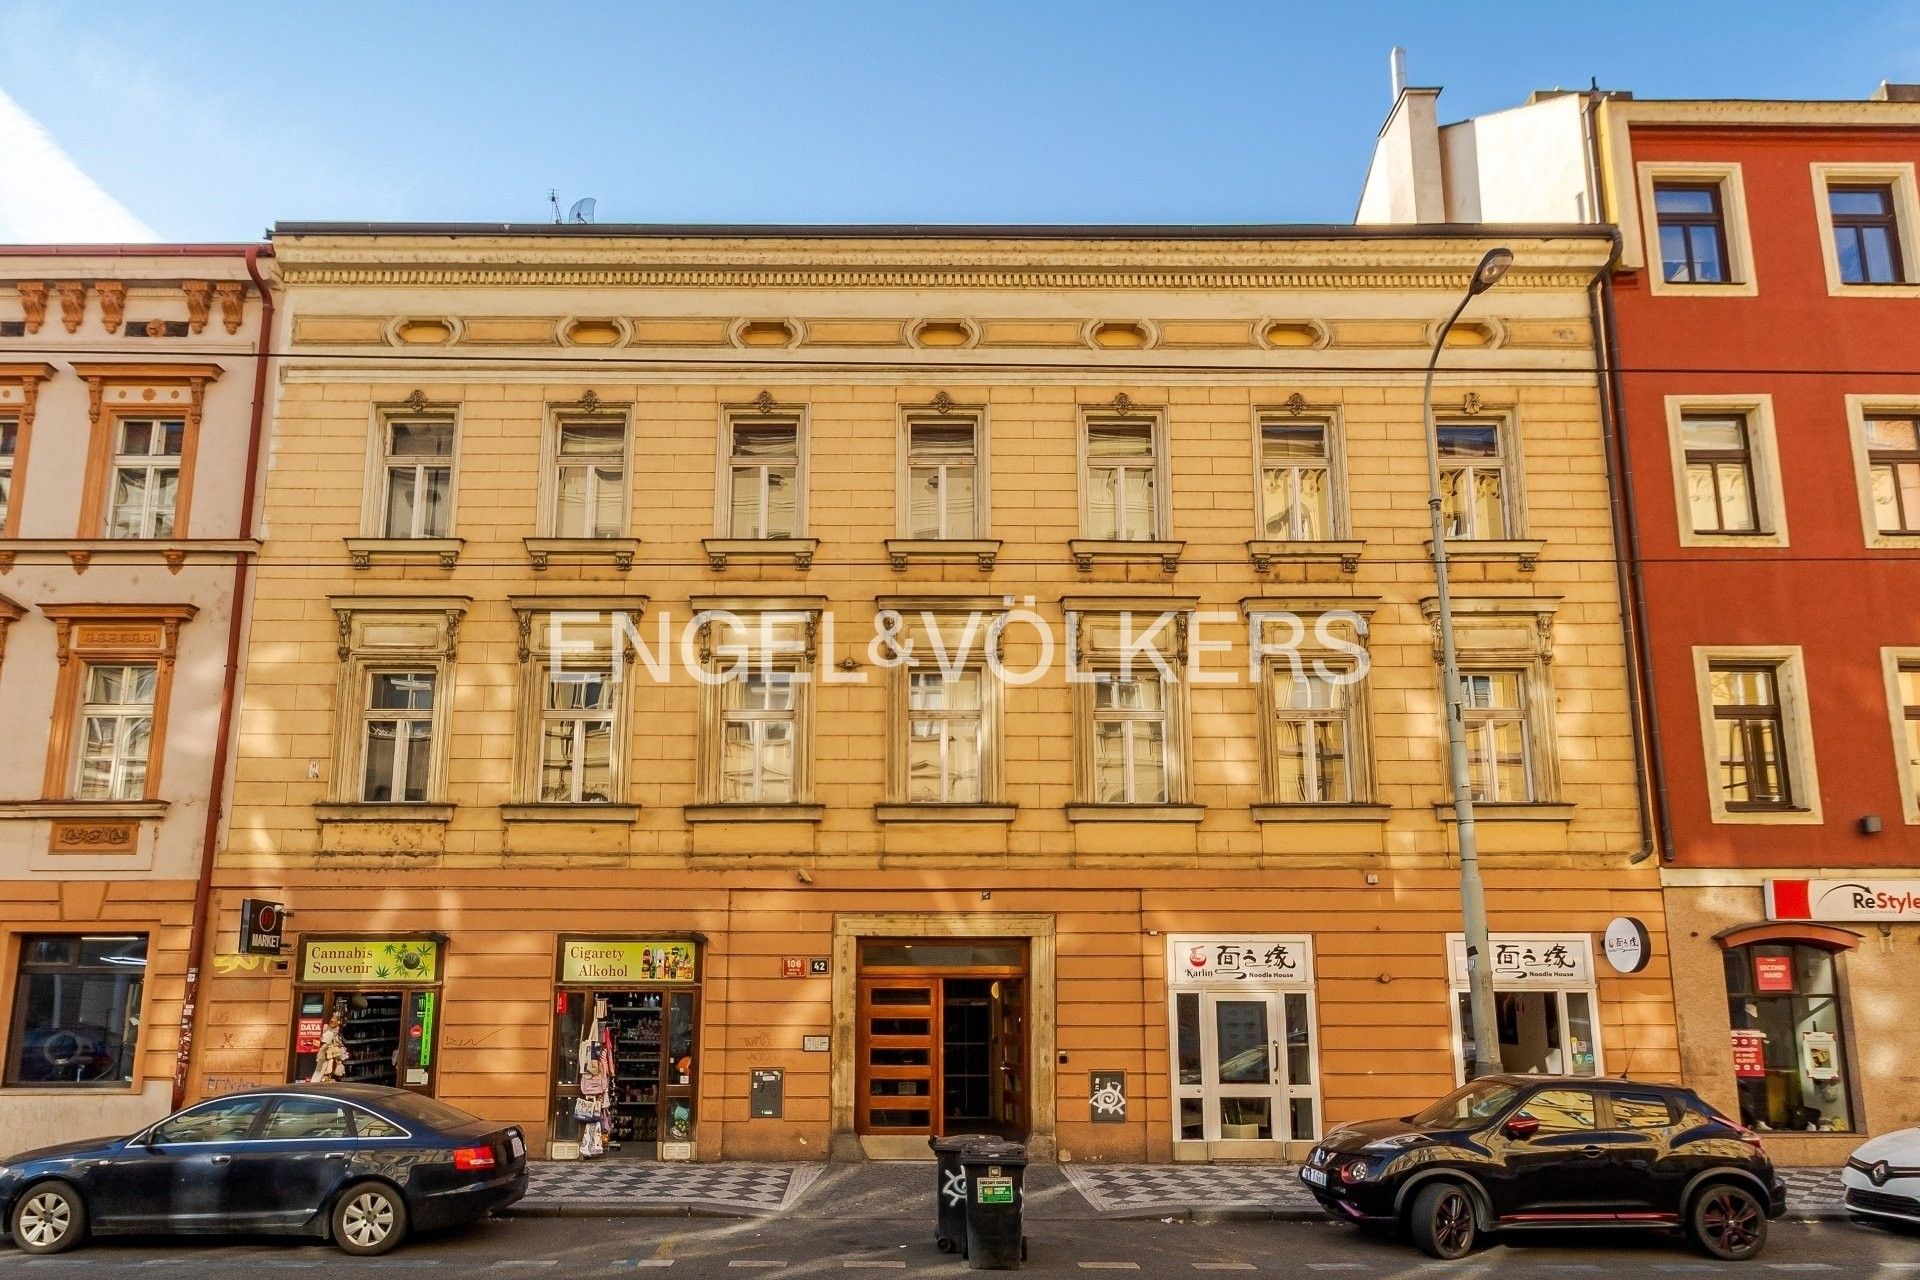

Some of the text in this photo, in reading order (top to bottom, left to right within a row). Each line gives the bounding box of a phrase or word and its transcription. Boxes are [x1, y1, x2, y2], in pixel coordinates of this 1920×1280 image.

[1852, 892, 1920, 914] ReStyle
[251, 933, 281, 948] MARKET
[311, 946, 374, 959] Cannabis
[570, 946, 625, 961] Cigarety
[312, 961, 373, 974] Souvenir
[787, 959, 802, 968] 106
[814, 962, 825, 971] 42
[578, 964, 628, 977] Alkohol
[300, 1023, 321, 1031] DATA
